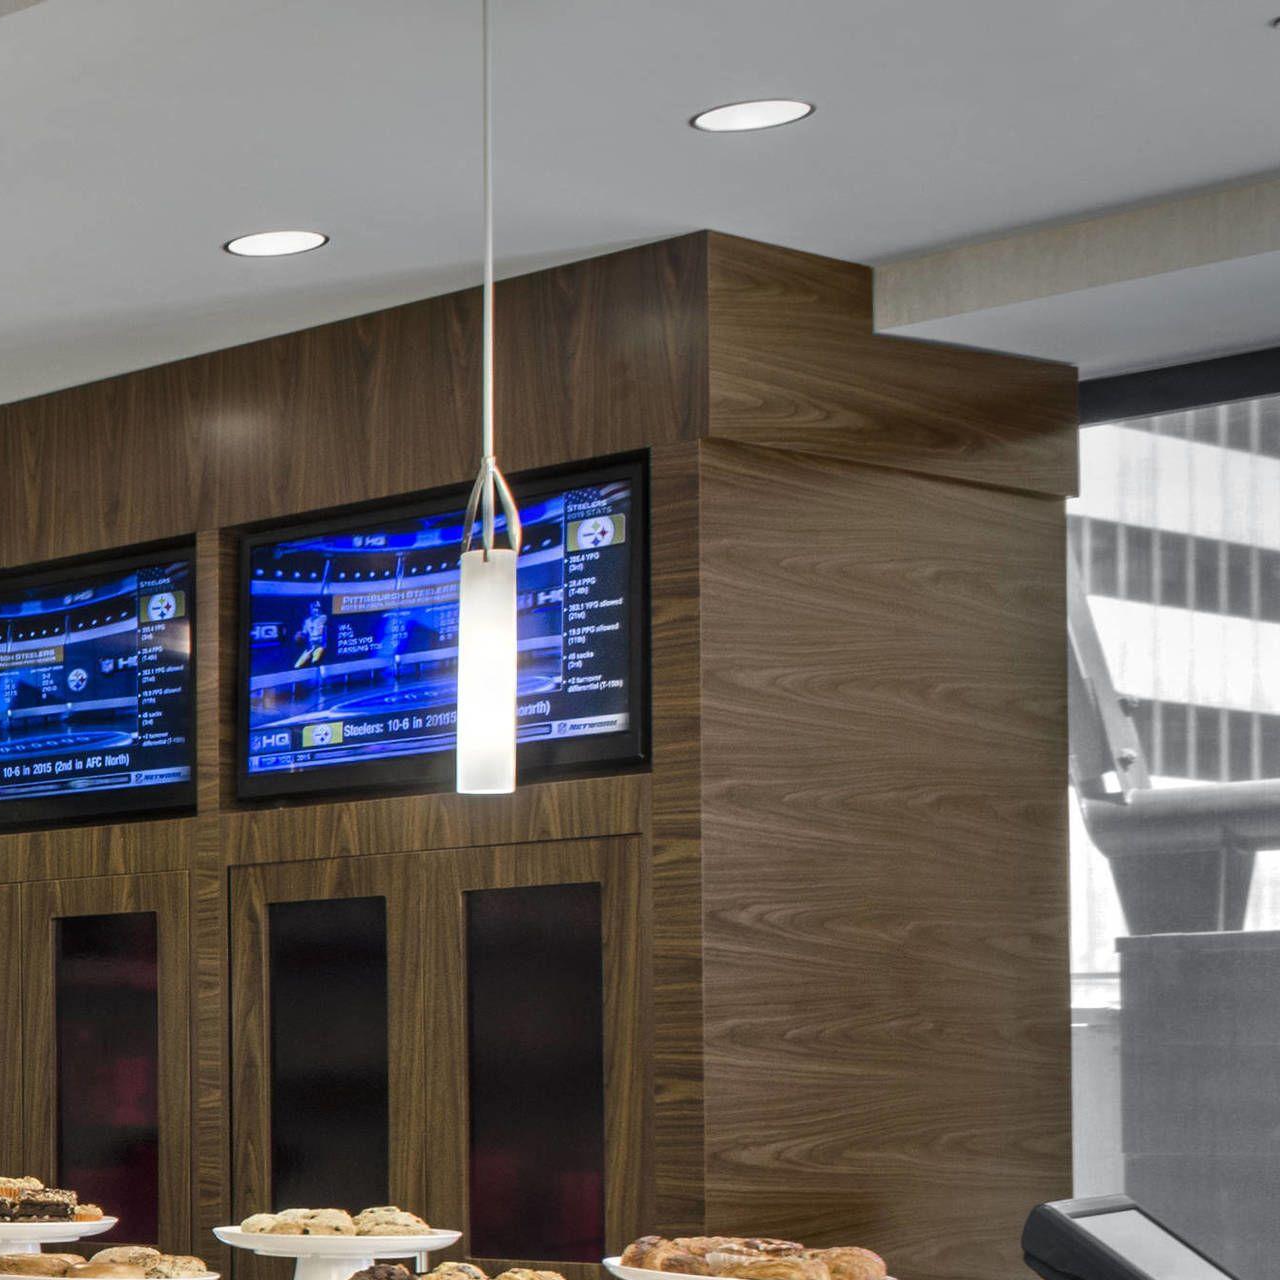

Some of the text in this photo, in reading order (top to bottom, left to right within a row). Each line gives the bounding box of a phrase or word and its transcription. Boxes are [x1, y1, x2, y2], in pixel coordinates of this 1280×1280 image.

[3, 767, 20, 778] 10-6
[23, 766, 30, 776] in
[32, 763, 52, 774] 2015
[75, 759, 83, 770] in
[85, 757, 102, 768] AFC
[105, 754, 129, 767] North)
